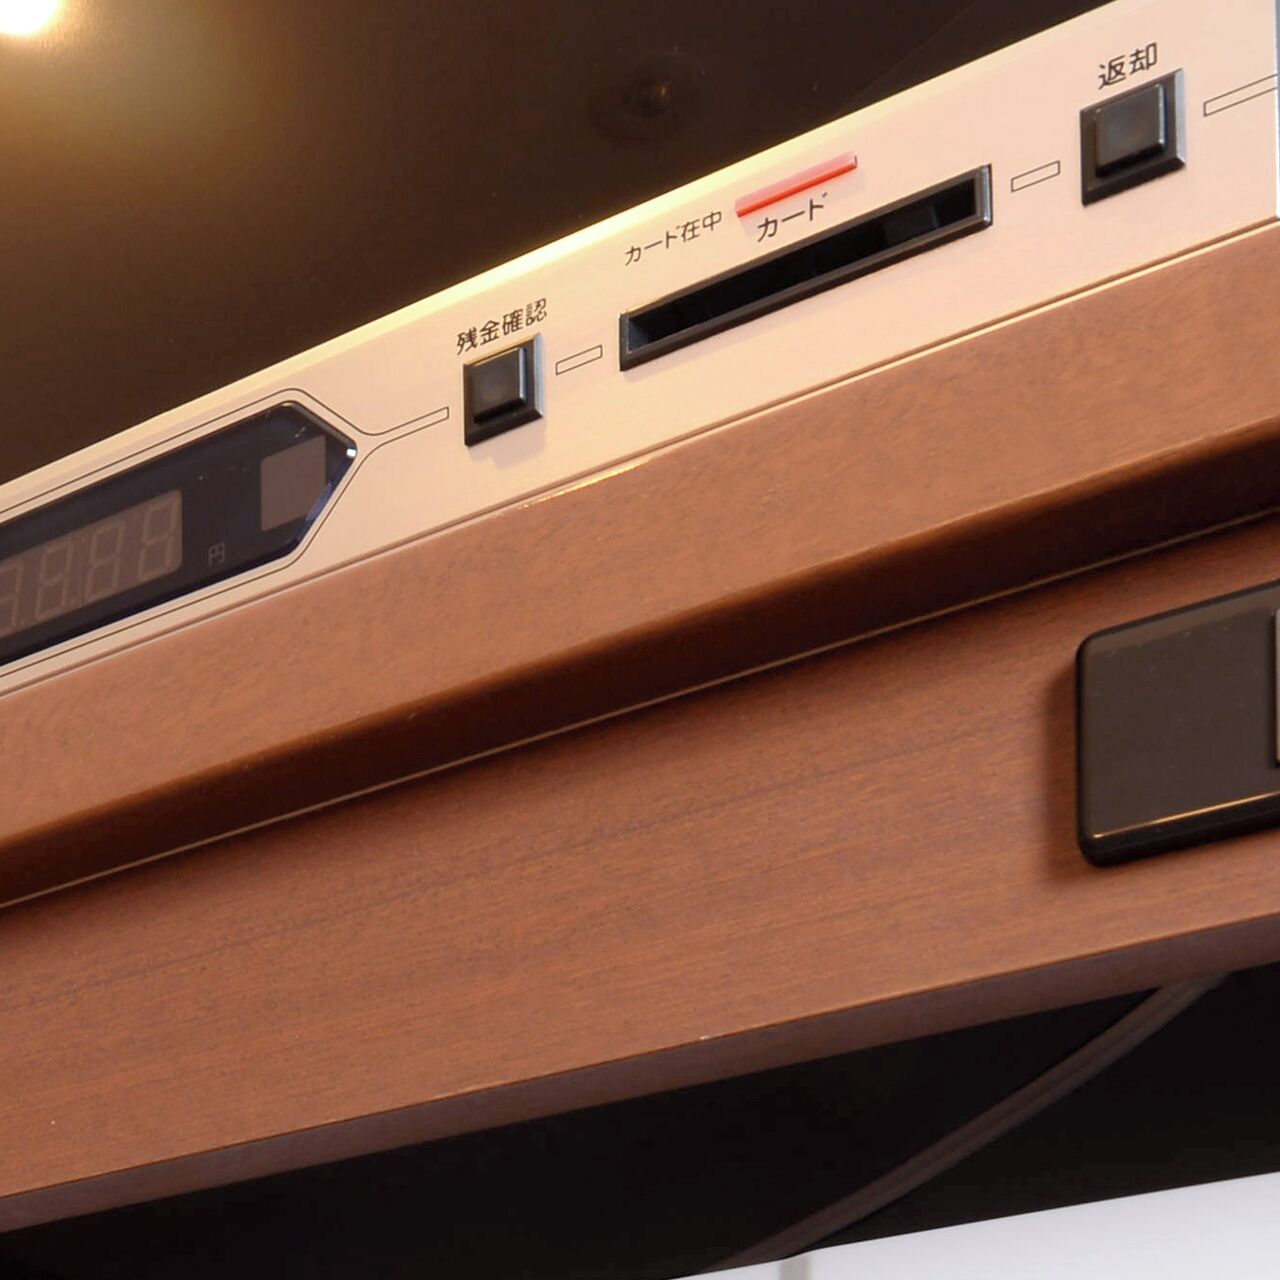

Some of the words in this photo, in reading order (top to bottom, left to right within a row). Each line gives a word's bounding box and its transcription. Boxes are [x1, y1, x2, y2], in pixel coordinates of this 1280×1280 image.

[1098, 41, 1157, 90] 返却
[625, 211, 723, 266] カード在中
[757, 192, 828, 242] カード
[456, 298, 547, 356] 残金確認
